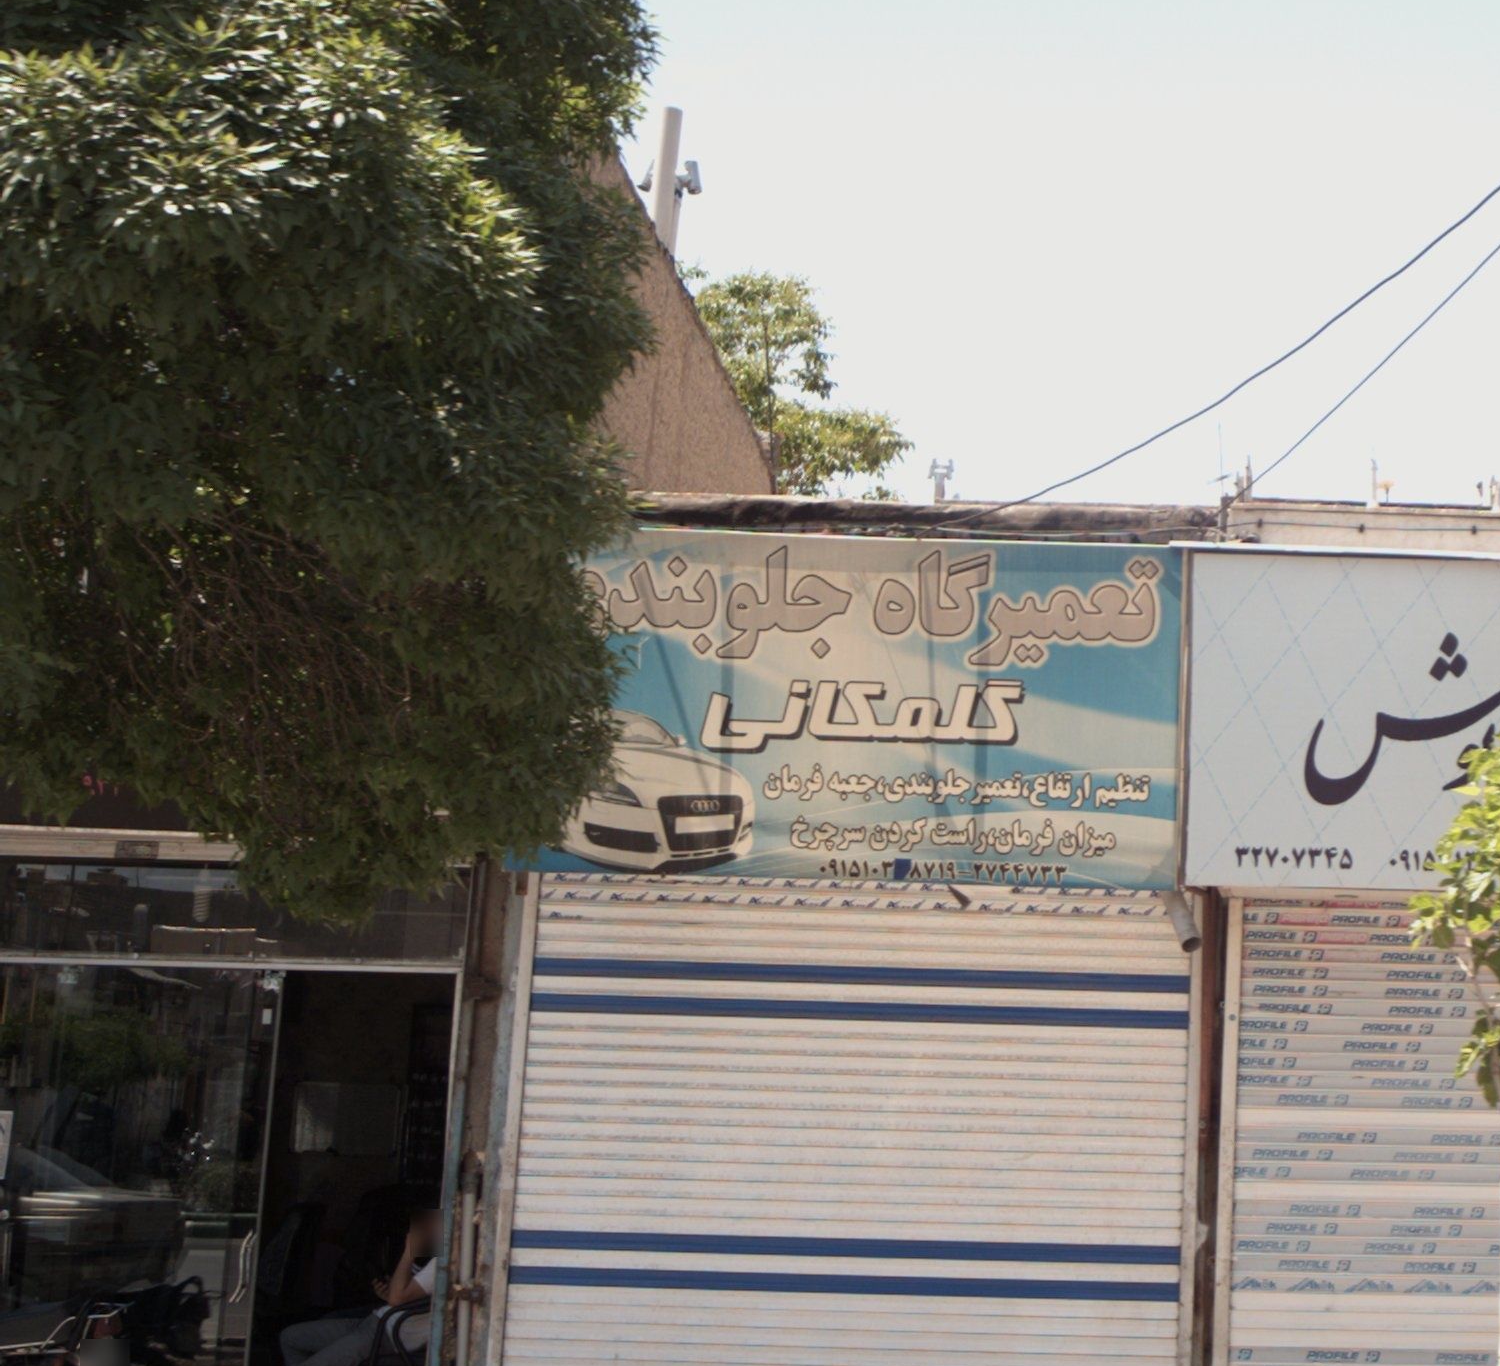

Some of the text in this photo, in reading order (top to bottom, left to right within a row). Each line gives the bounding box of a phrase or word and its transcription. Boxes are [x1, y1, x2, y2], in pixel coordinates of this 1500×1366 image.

[873, 550, 1160, 667] تعمیرگاه
[701, 678, 1022, 752] گلمکانی
[762, 763, 824, 802] فرمان
[1095, 771, 1151, 808] تنظیم
[868, 817, 928, 853] کردن
[1058, 820, 1117, 858] میزان
[1235, 846, 1353, 870] ۳۲۷۰۷۳۴۵
[1331, 914, 1381, 924] PROFILE
[1246, 930, 1297, 940] PROFILE
[1248, 948, 1302, 958] PROFILE
[1381, 952, 1436, 962] PROFILE
[1252, 966, 1306, 976] PROFILE
[1388, 970, 1443, 980] PROFILE
[1252, 985, 1305, 995] PROFILE
[1386, 987, 1441, 997] PROFILE
[1257, 1002, 1311, 1012] PROFILE
[1389, 1005, 1444, 1015] PROFILE
[1362, 1022, 1412, 1032] PROFILE
[1344, 1040, 1398, 1050] PROFILE
[1352, 1058, 1406, 1068] PROFILE
[1372, 1078, 1431, 1088] PROFILE
[1278, 1094, 1329, 1104] PROFILE
[1402, 1096, 1453, 1106] PROFILE
[1297, 1131, 1355, 1141] PROFILE
[1432, 1134, 1483, 1144] PROFILE
[1251, 1148, 1309, 1158] PROFILE
[1394, 1151, 1453, 1161] PROFILE
[1351, 1169, 1410, 1179] PROFILE
[1290, 1204, 1341, 1214] PROFILE
[1414, 1206, 1465, 1216] PROFILE
[1267, 1222, 1318, 1232] PROFILE
[1391, 1224, 1442, 1234] PROFILE
[1238, 1240, 1289, 1250] PROFILE
[1365, 1242, 1416, 1252] PROFILE
[1279, 1259, 1330, 1269] PROFILE
[1405, 1261, 1456, 1271] PROFILE
[1306, 1349, 1360, 1359] PROFILE
